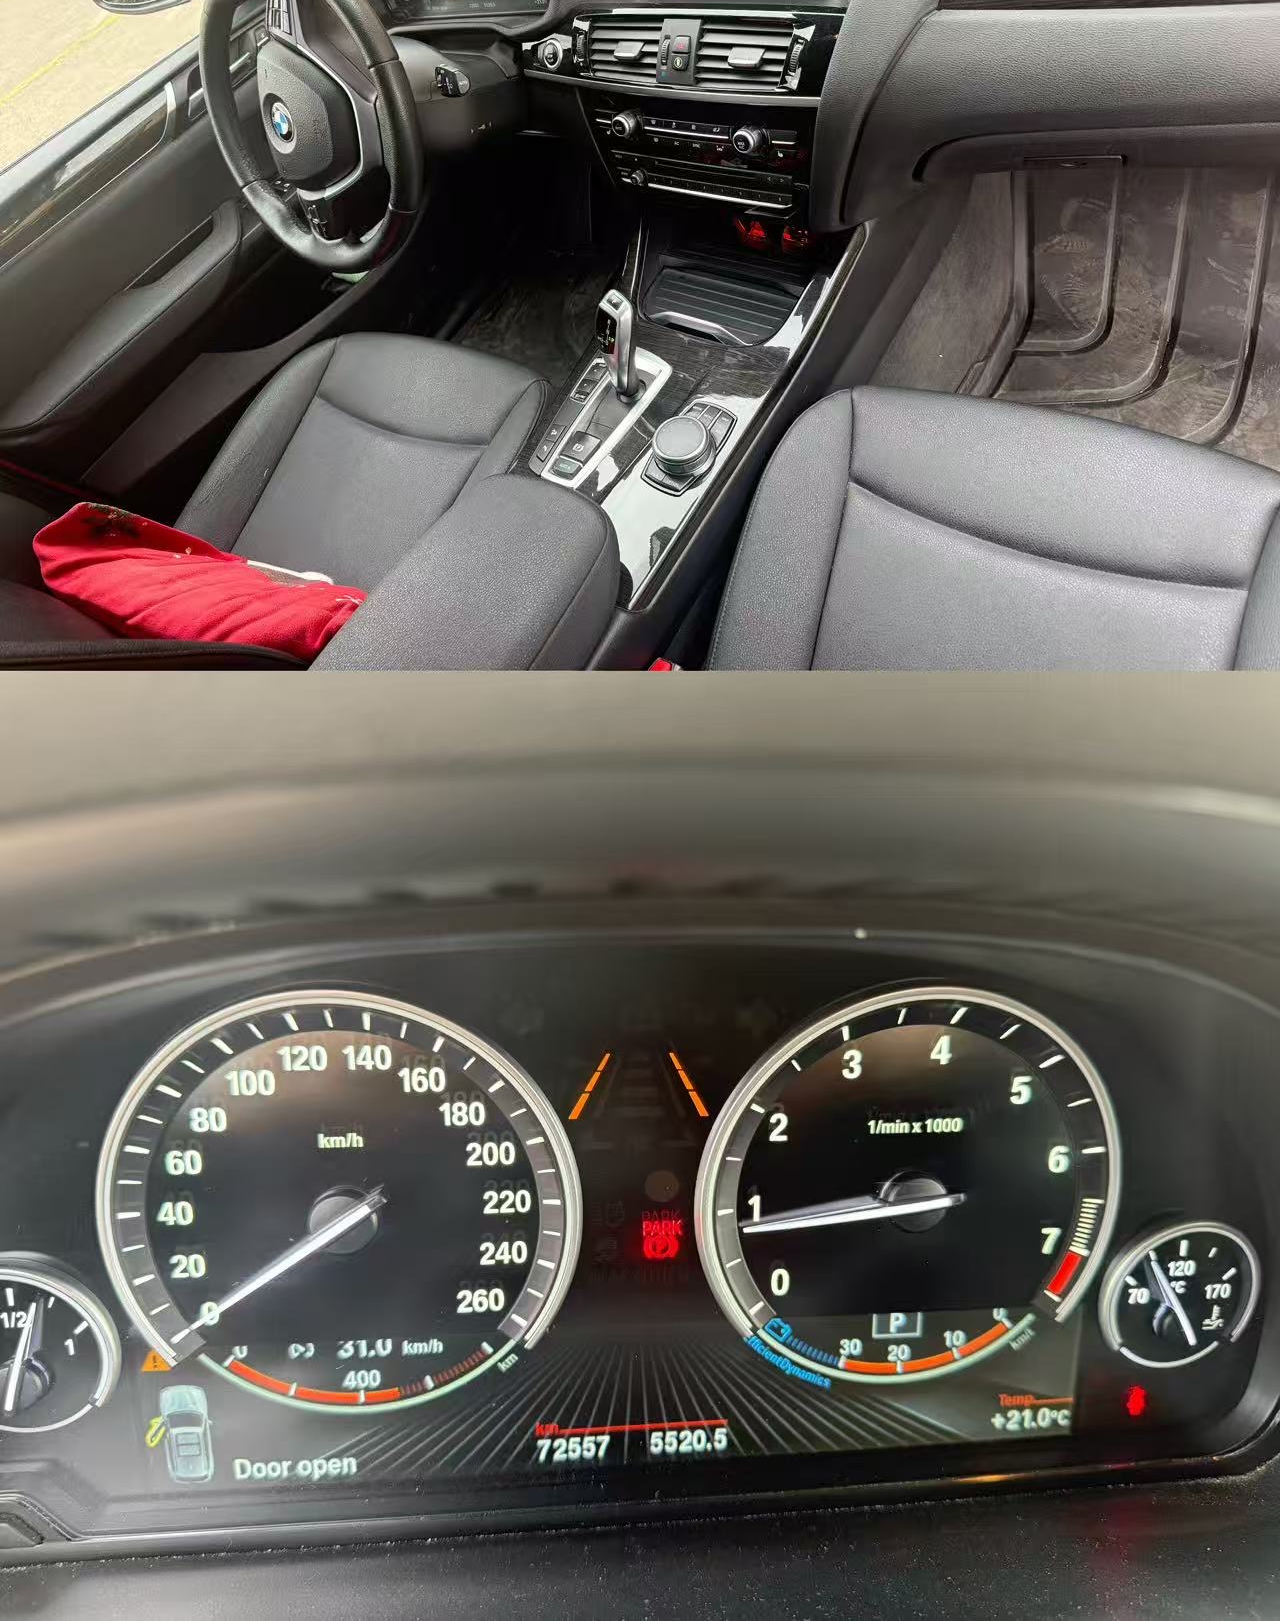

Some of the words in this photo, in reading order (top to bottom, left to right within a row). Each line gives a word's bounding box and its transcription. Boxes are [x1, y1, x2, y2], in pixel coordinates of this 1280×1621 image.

[276, 1044, 328, 1072] 120
[341, 1044, 392, 1071] 140
[931, 1035, 952, 1065] 4
[841, 1049, 863, 1079] 3
[224, 1069, 276, 1096] 100
[397, 1067, 446, 1093] 160
[1010, 1075, 1033, 1105] 5
[188, 1107, 228, 1133] 80
[438, 1101, 486, 1127] 180
[867, 1120, 910, 1135] 1/min
[911, 1123, 923, 1134] x
[925, 1117, 964, 1134] 1000
[317, 1132, 364, 1149] km/h
[769, 1113, 789, 1142] 2
[164, 1149, 203, 1176] 60
[465, 1141, 516, 1167] 200
[1048, 1145, 1071, 1174] 6
[155, 1200, 194, 1226] 40
[482, 1189, 532, 1215] 220
[747, 1194, 761, 1222] 1
[642, 1220, 683, 1236] PARK
[1041, 1227, 1062, 1255] 7
[169, 1253, 207, 1279] 20
[479, 1240, 528, 1266] 240
[1167, 1259, 1197, 1277] 120
[770, 1268, 790, 1296] 0
[1204, 1283, 1232, 1300] 170
[455, 1288, 505, 1314] 260
[1127, 1288, 1150, 1305] 70
[0, 1310, 28, 1329] 1/2
[200, 1301, 220, 1326] 0
[889, 1312, 907, 1334] P
[64, 1338, 75, 1356] 1
[336, 1338, 393, 1360] 31.0
[401, 1338, 444, 1355] km/h
[838, 1338, 864, 1356] 30
[944, 1330, 967, 1348] 10
[887, 1344, 912, 1362] 20
[342, 1369, 382, 1388] 400
[535, 1435, 611, 1464] 72557
[650, 1427, 728, 1456] 5520.5
[232, 1457, 292, 1480] Door
[295, 1455, 358, 1482] open
